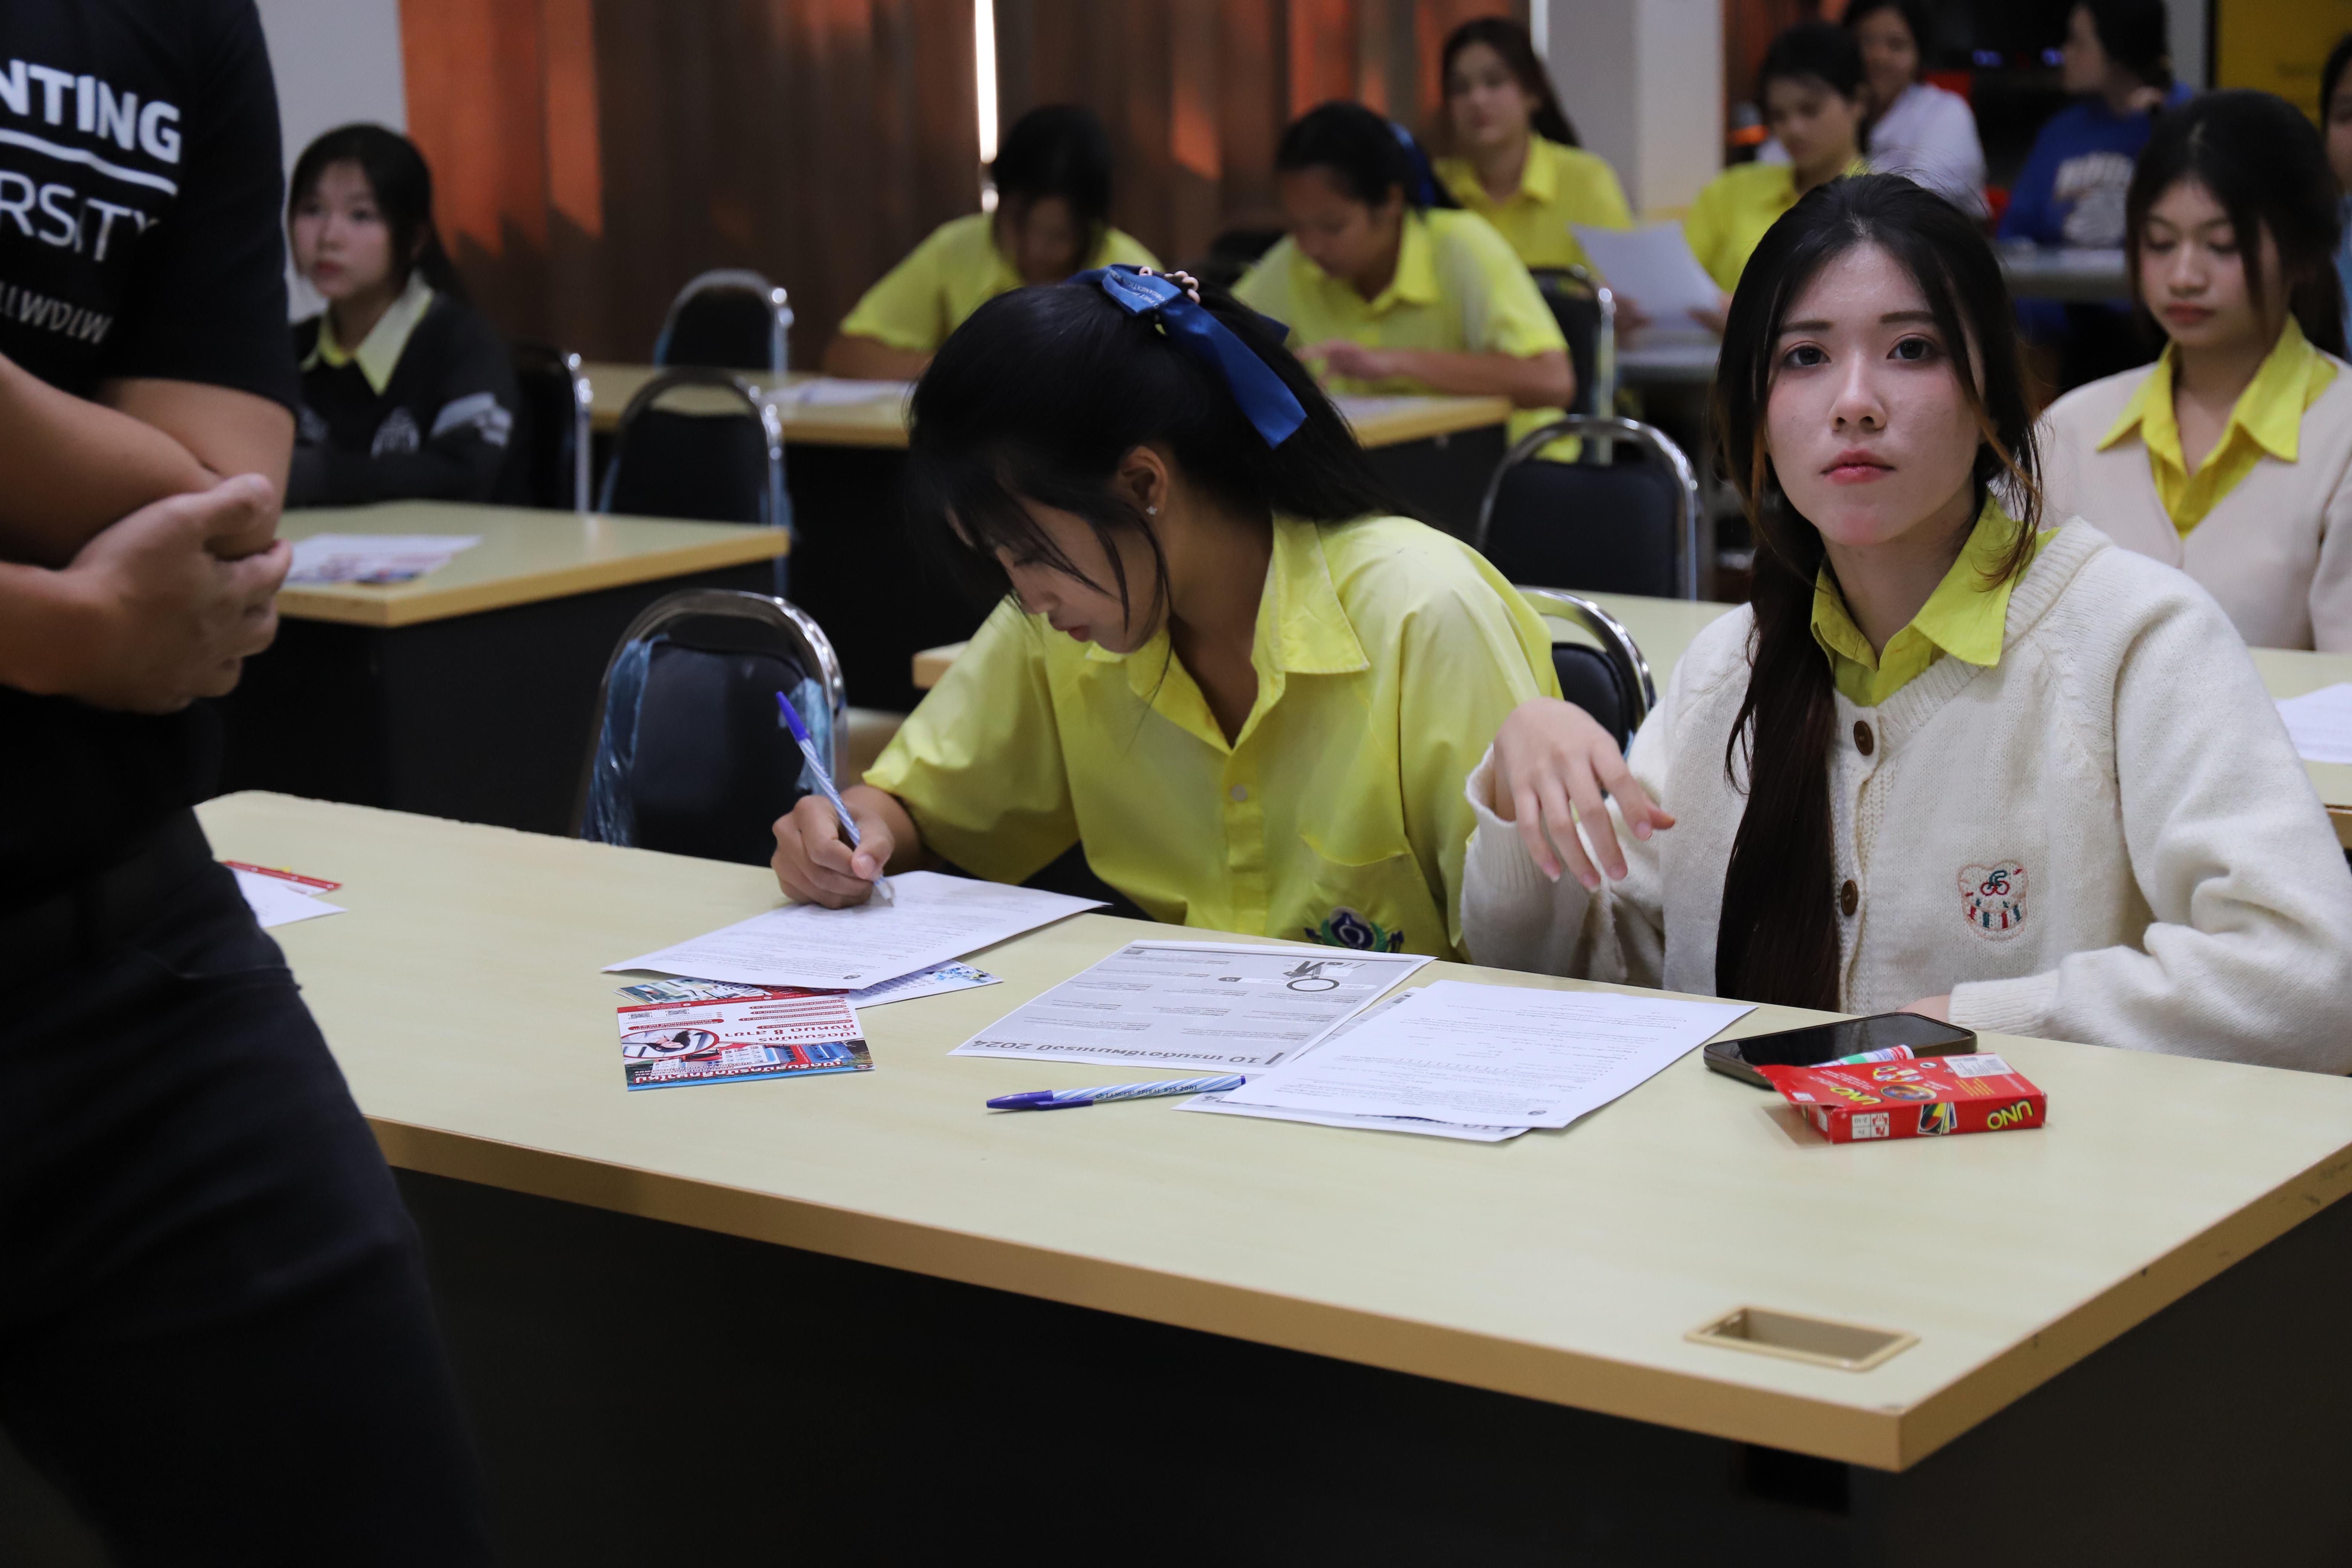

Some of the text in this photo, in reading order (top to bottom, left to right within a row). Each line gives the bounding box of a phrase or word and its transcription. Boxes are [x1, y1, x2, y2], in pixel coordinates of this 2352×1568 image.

[758, 1031, 856, 1041] เปิดรับสมัคร
[790, 1024, 854, 1032] ทั้งหมด
[970, 1040, 1032, 1049] 2024
[1035, 1044, 1223, 1060] เทรนด์อาชีพมาแรงปี
[634, 1061, 842, 1083] เปิดรับสมัครนักศึกษาใหม่
[1830, 1086, 1883, 1105] UNO
[1987, 1099, 2033, 1129] UNO
